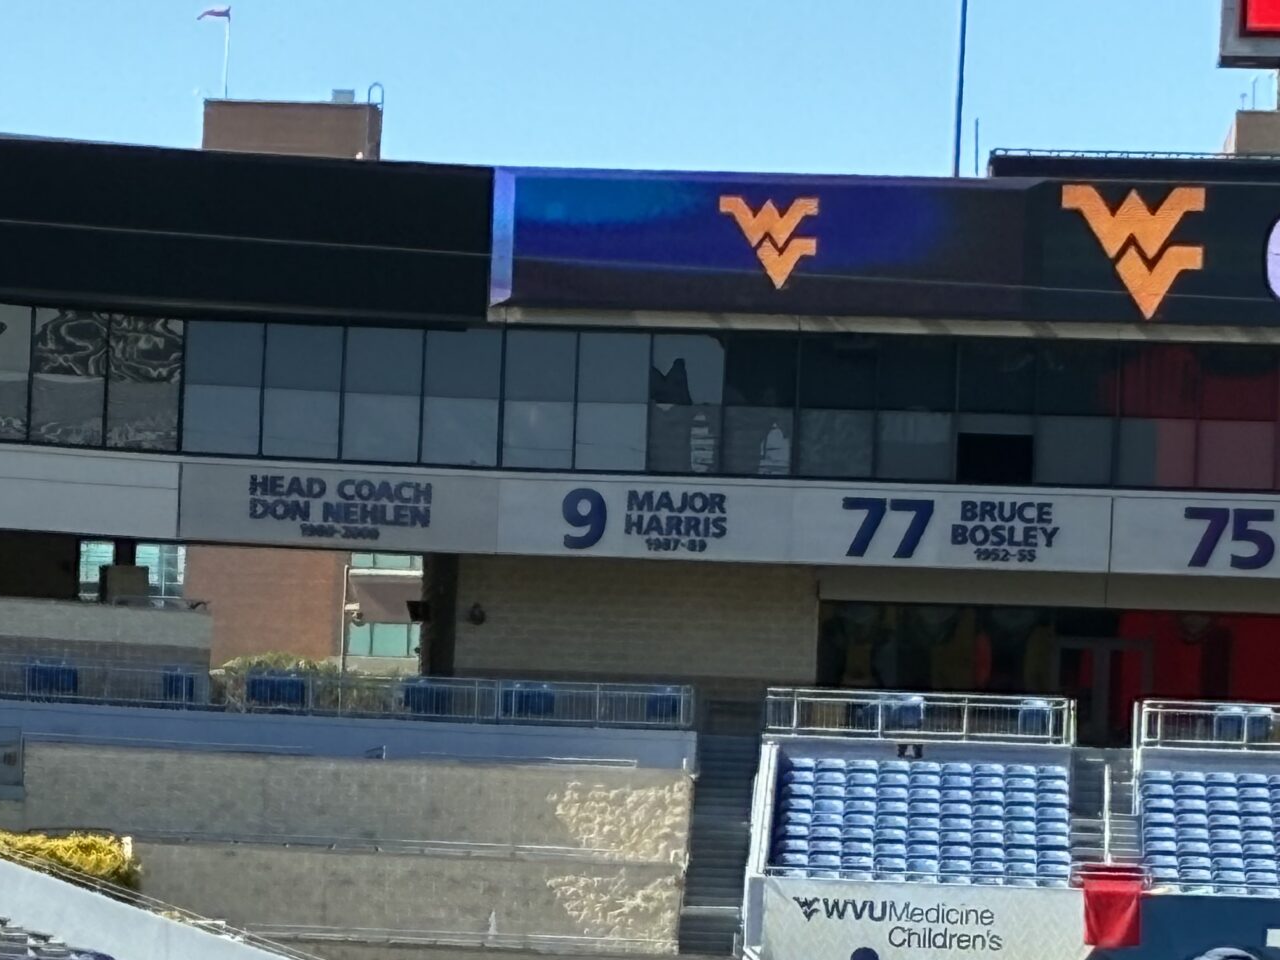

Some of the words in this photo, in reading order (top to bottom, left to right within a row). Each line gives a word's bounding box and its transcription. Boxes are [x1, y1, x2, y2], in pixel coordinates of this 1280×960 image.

[249, 474, 327, 498] HEAD
[337, 478, 433, 504] COACH
[627, 490, 727, 514] MAJOR
[249, 498, 310, 522] DON
[322, 501, 431, 528] NEHLEN
[562, 487, 607, 549] 9
[624, 513, 728, 538] HARRIS
[960, 500, 1053, 524] BRUCE
[842, 496, 934, 558] 77
[951, 524, 1060, 548] BOSLEY
[1184, 506, 1275, 570] 75
[888, 925, 1003, 951] Children's
